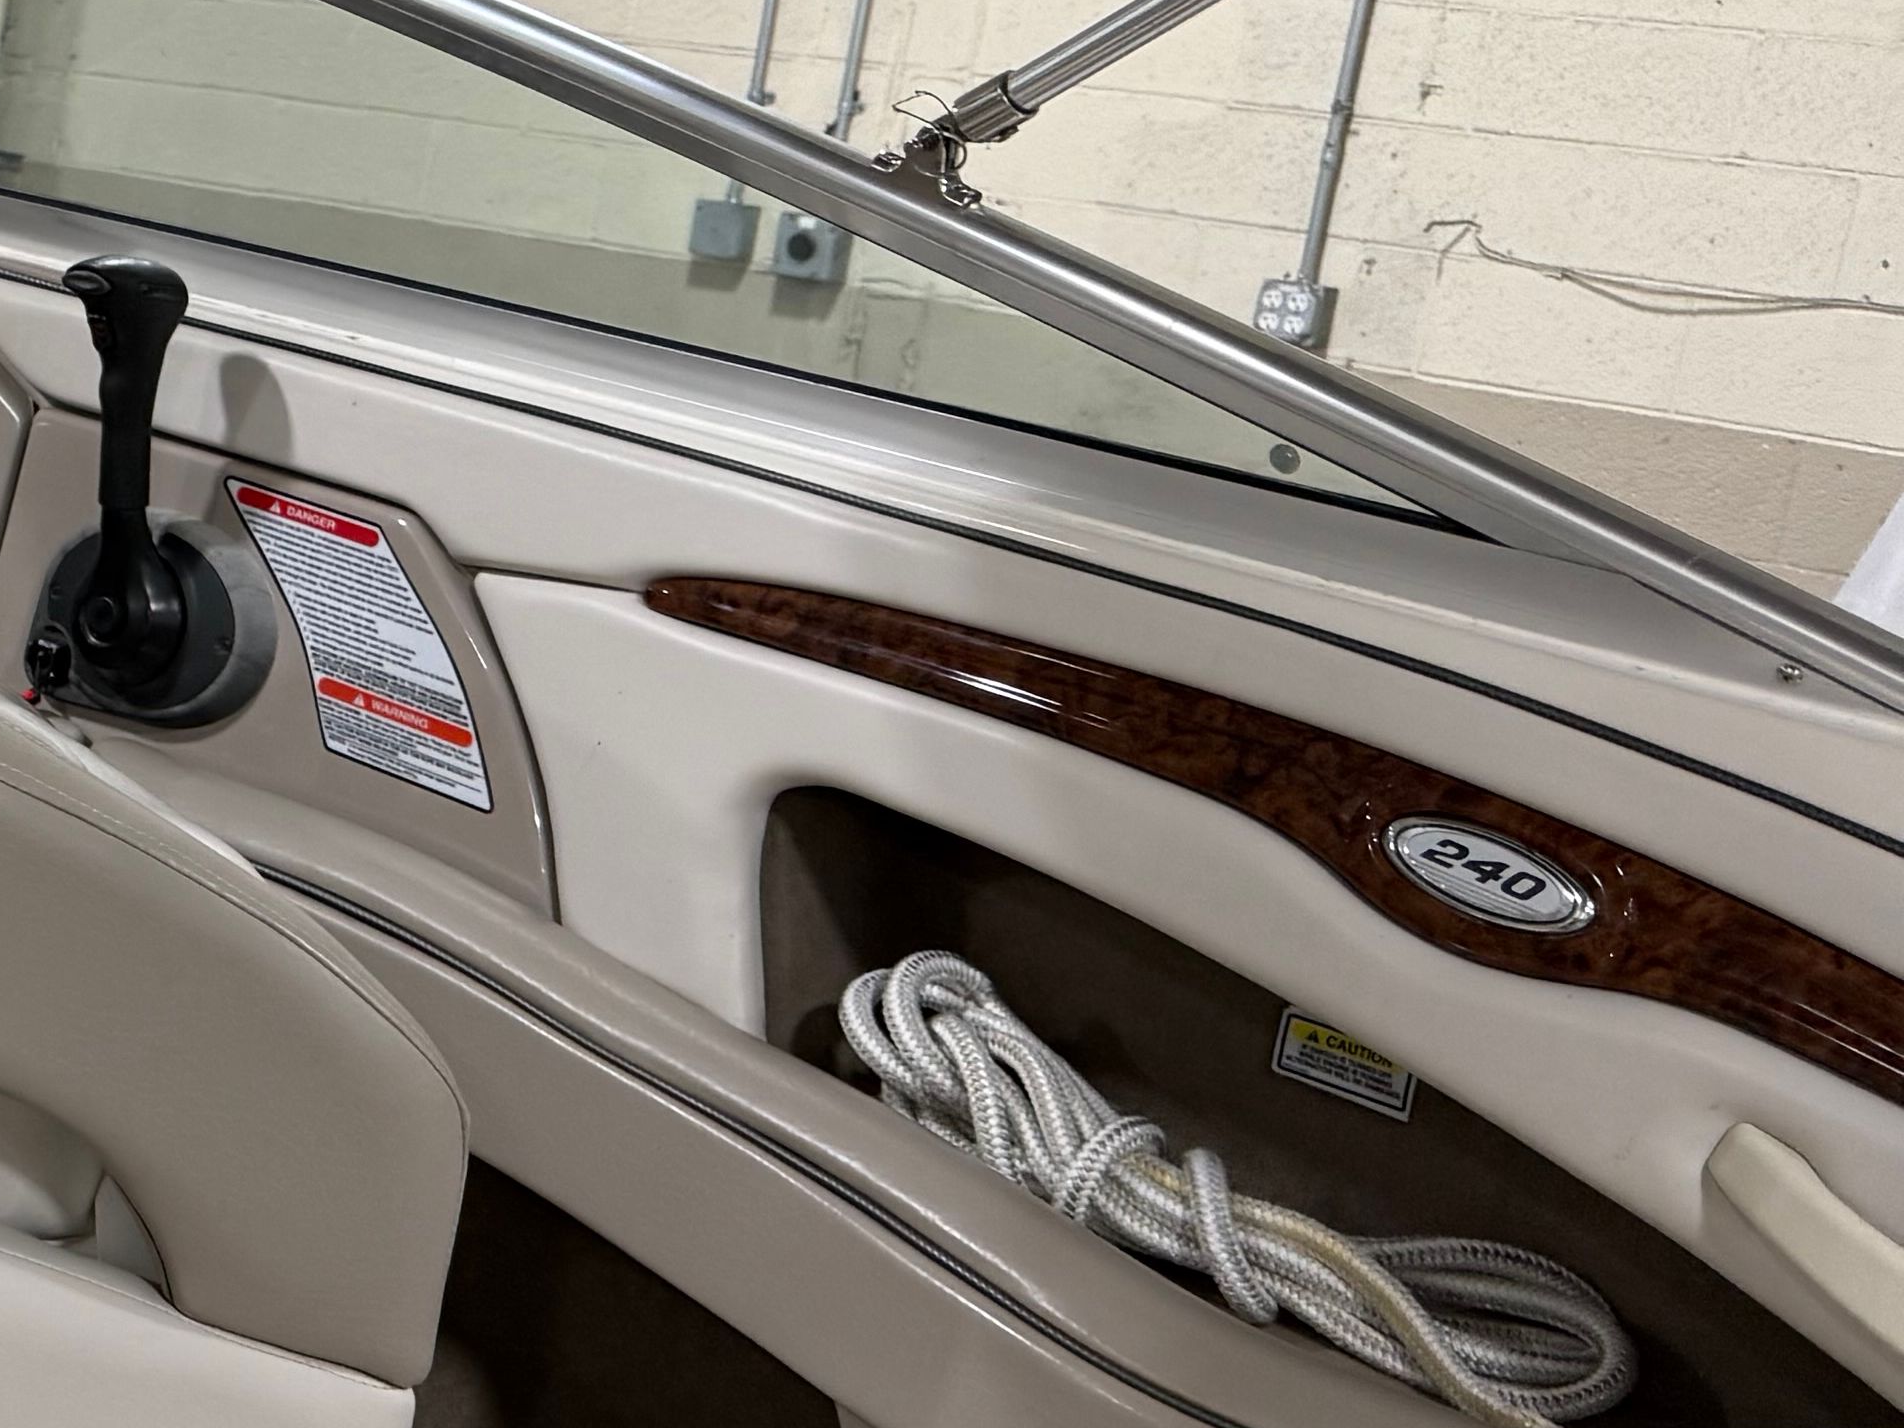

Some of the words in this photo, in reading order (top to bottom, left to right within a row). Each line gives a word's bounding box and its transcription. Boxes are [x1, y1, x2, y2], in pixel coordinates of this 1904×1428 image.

[286, 505, 336, 531] DANGER
[371, 698, 429, 729] WARNING
[1419, 838, 1547, 901] 240
